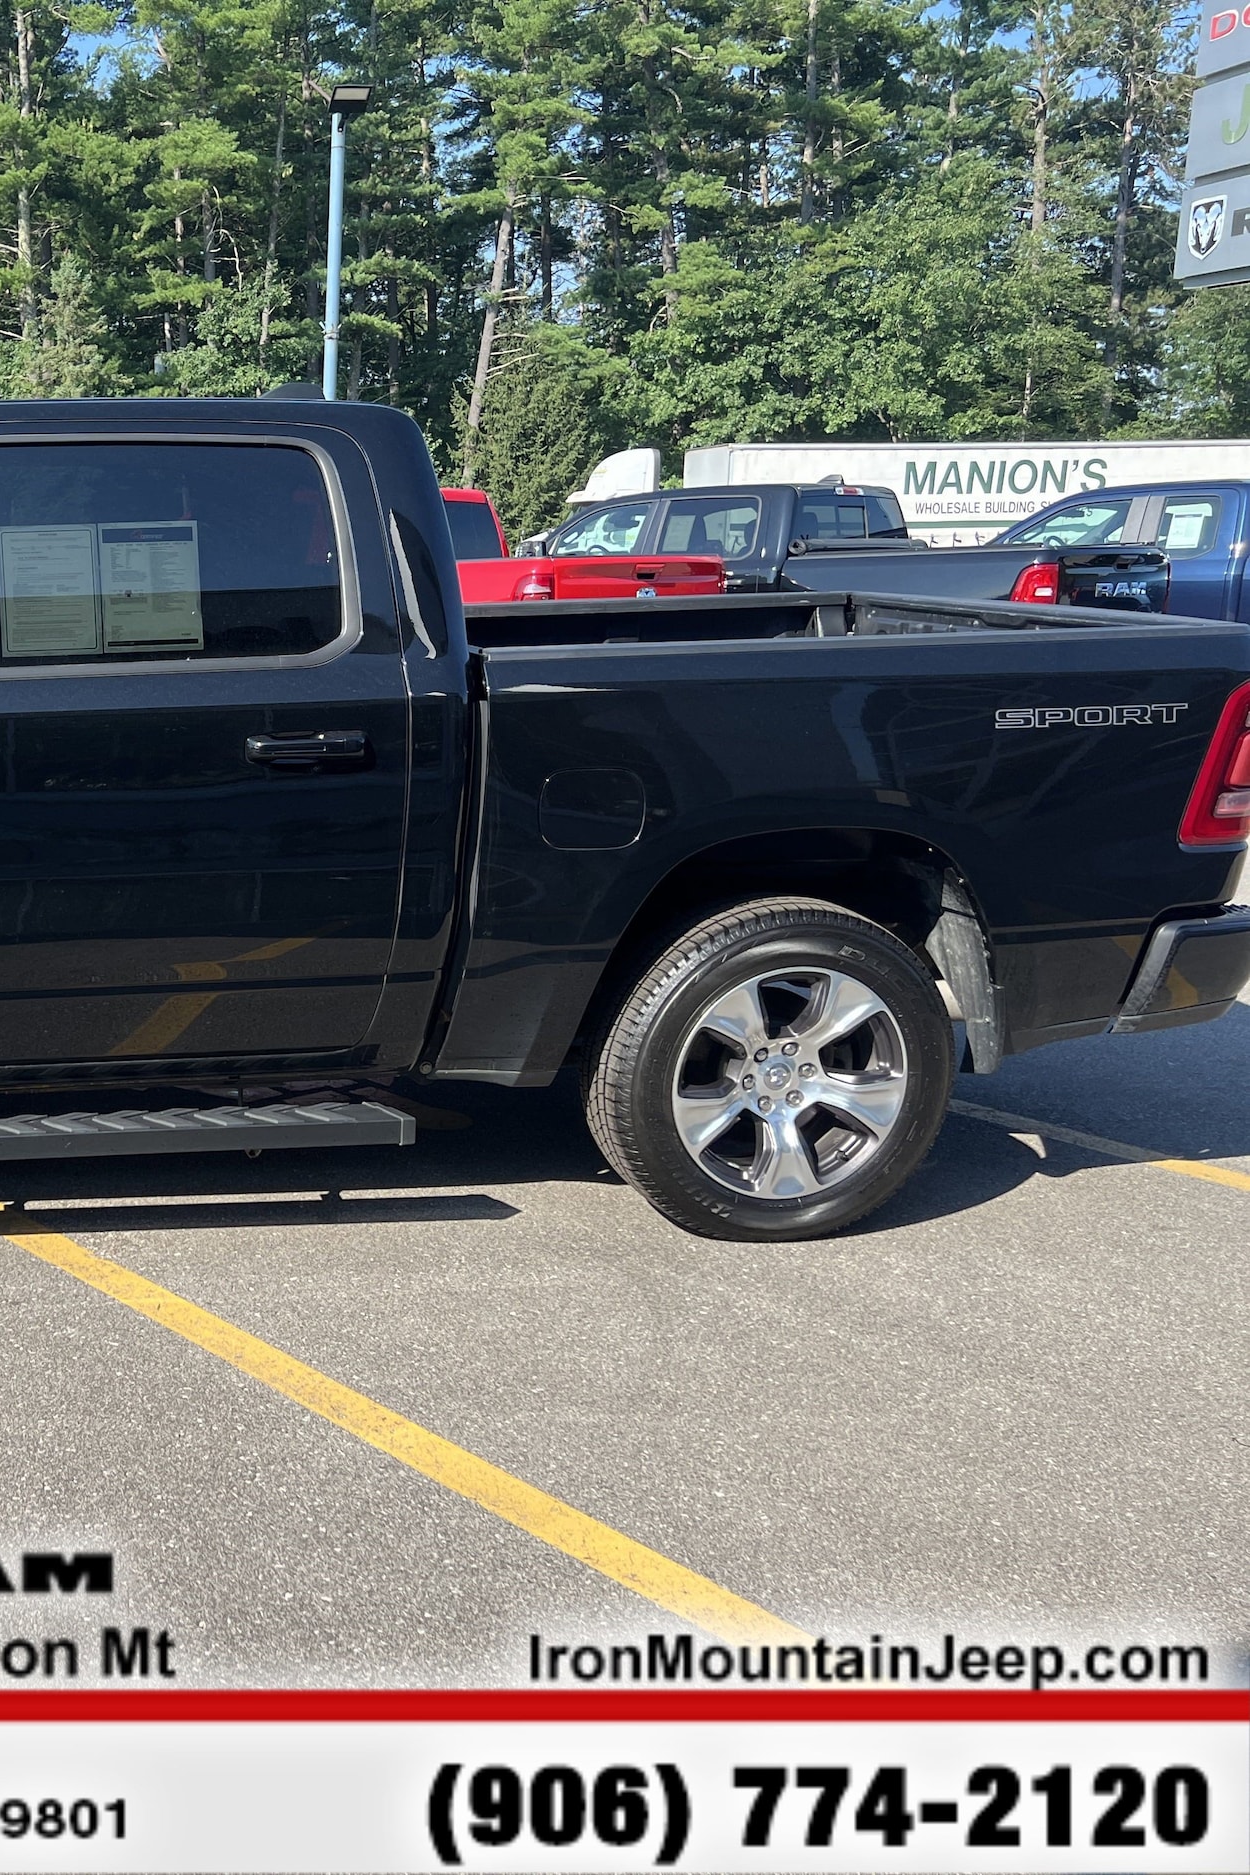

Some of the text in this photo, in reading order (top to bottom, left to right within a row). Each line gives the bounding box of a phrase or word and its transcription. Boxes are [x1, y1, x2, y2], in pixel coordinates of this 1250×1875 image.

[903, 458, 1108, 495] MANION'S
[915, 501, 981, 515] WHOLESALE
[985, 500, 1035, 514] BUILDING
[1094, 581, 1148, 598] RAM
[994, 702, 1189, 730] SPORT
